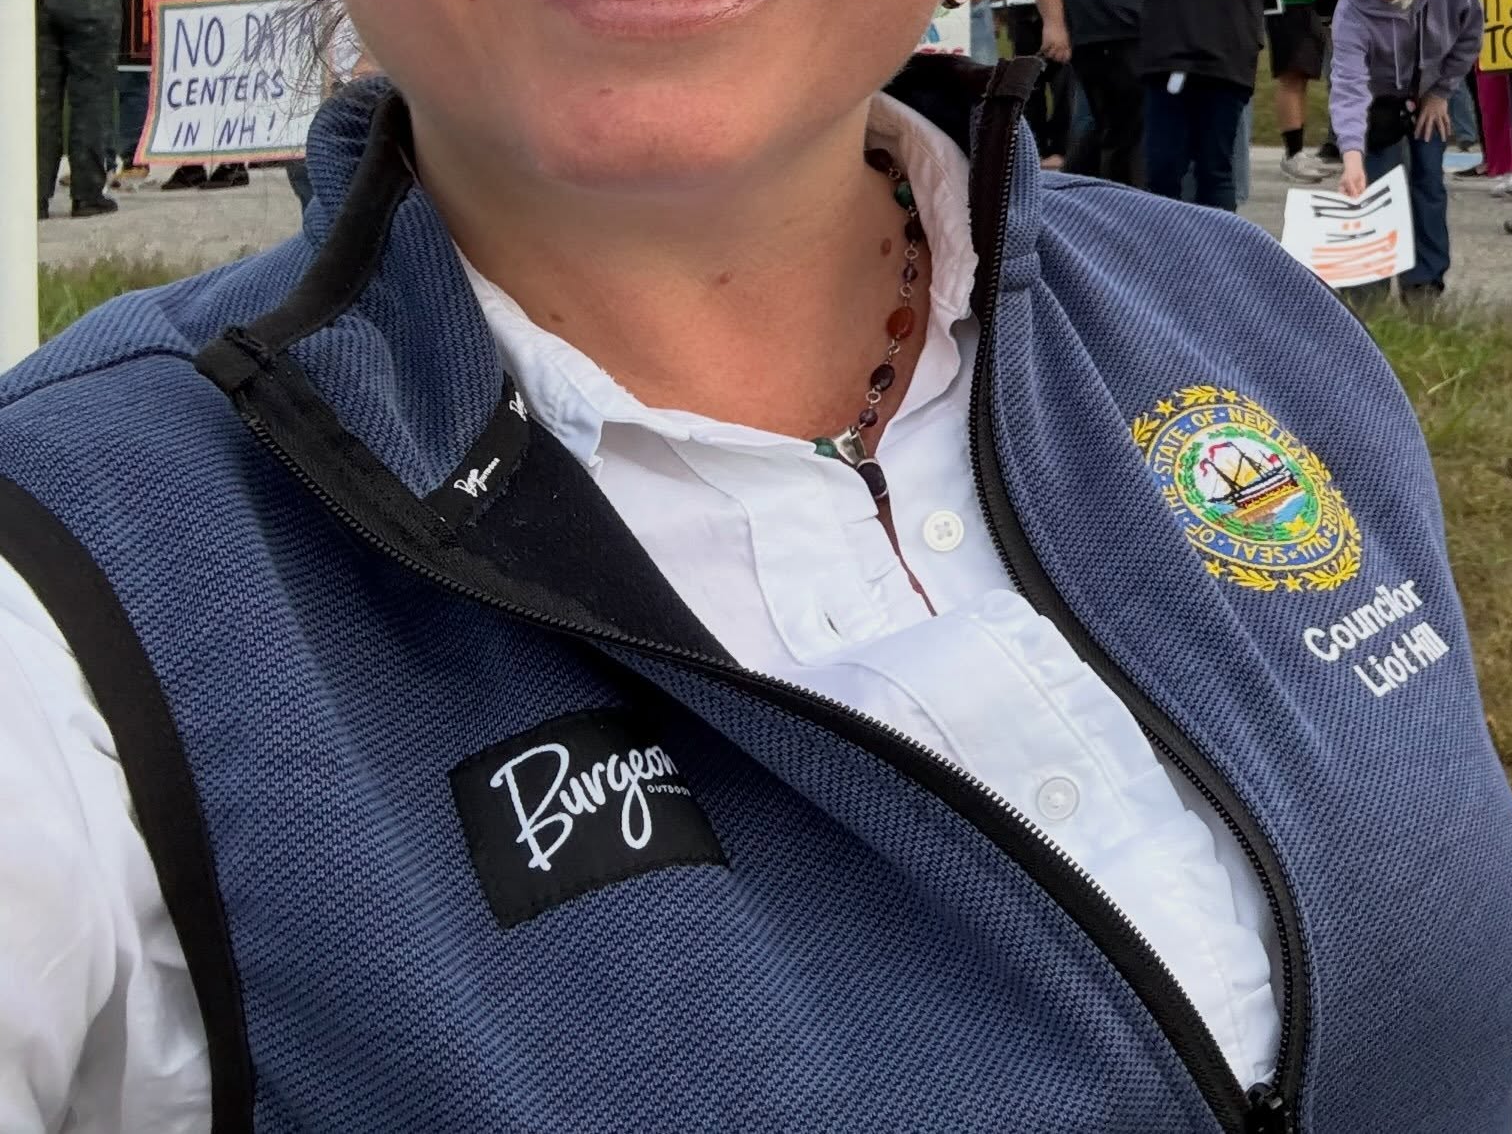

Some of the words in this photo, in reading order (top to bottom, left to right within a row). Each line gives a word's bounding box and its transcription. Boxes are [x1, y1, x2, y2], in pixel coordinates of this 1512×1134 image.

[173, 16, 225, 72] NO
[167, 69, 284, 109] CENTERS
[173, 121, 200, 148] IN
[1190, 410, 1217, 428] OF
[1228, 407, 1275, 435] NEW
[1153, 426, 1190, 475] STATE
[1162, 483, 1187, 516] THE
[1185, 522, 1216, 544] OF
[1229, 538, 1288, 565] SEAL
[1303, 579, 1423, 661] Councilor
[1352, 641, 1419, 698] Liot
[1401, 622, 1450, 667] Hill
[490, 743, 679, 871] Burgeon
